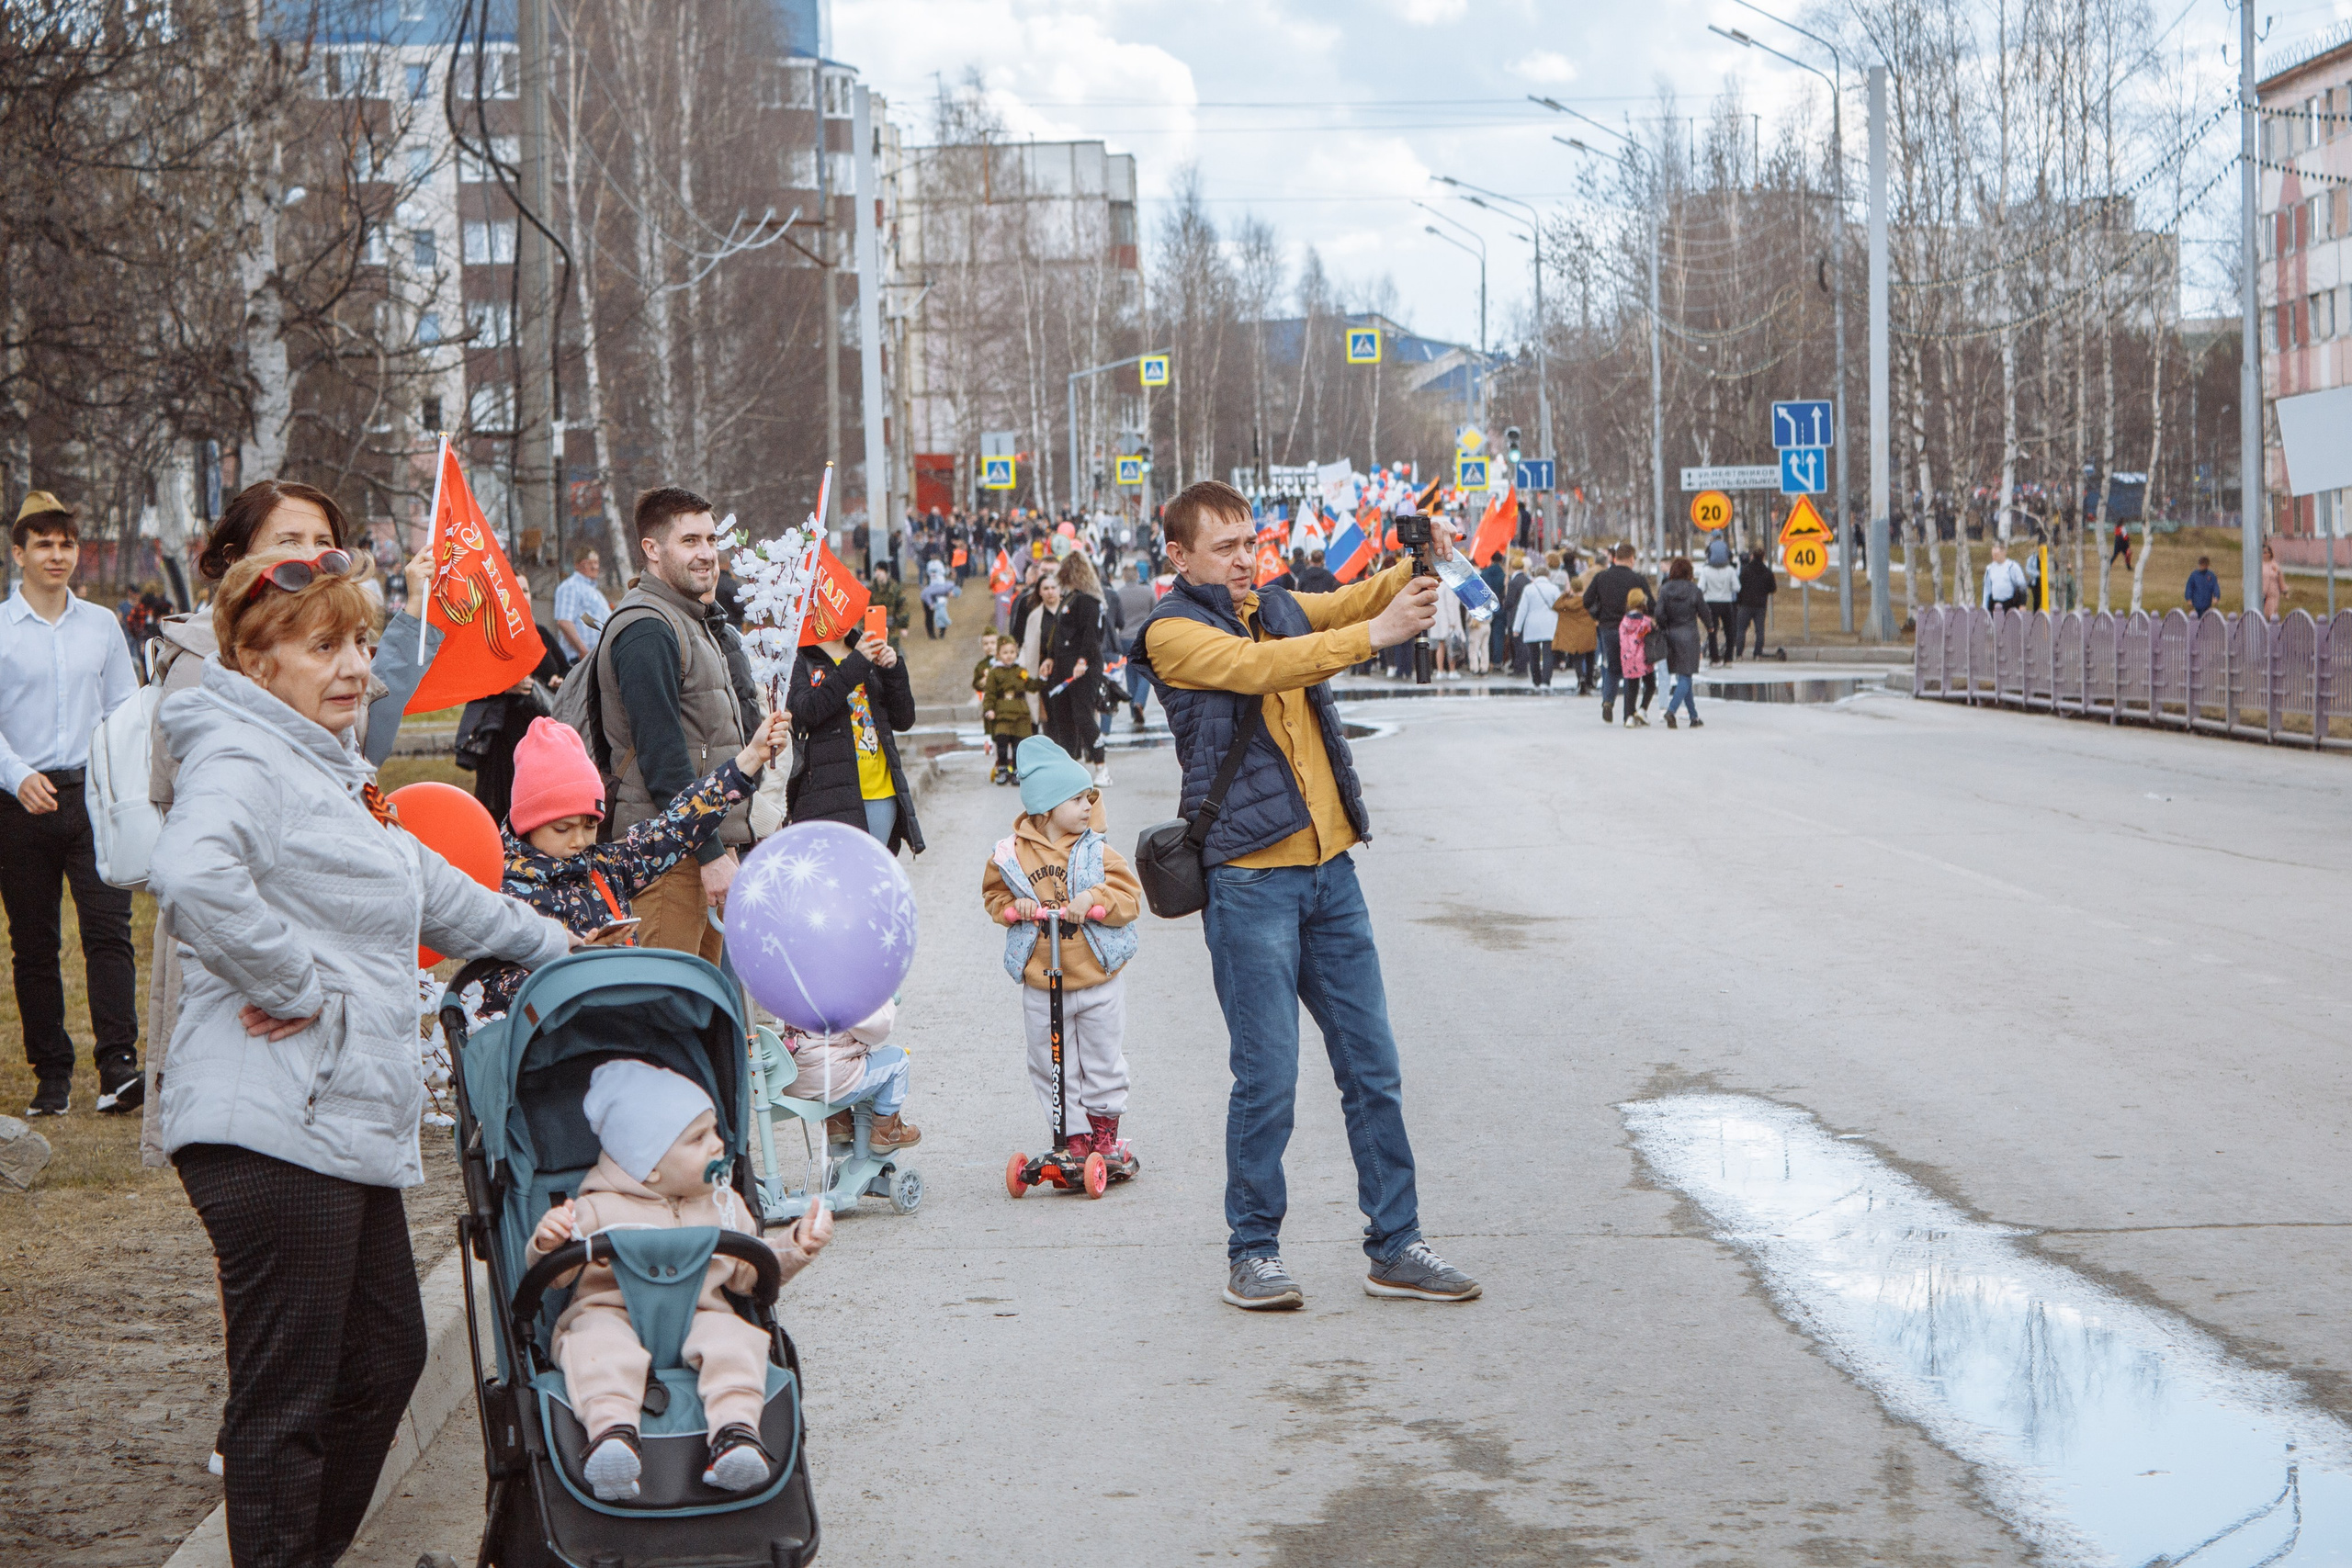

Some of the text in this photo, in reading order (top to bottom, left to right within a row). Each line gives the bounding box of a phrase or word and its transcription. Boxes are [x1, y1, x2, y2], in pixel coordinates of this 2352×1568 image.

[1702, 505, 1722, 521] 20
[1794, 549, 1815, 566] 40
[460, 521, 526, 639] 9 МАЯ
